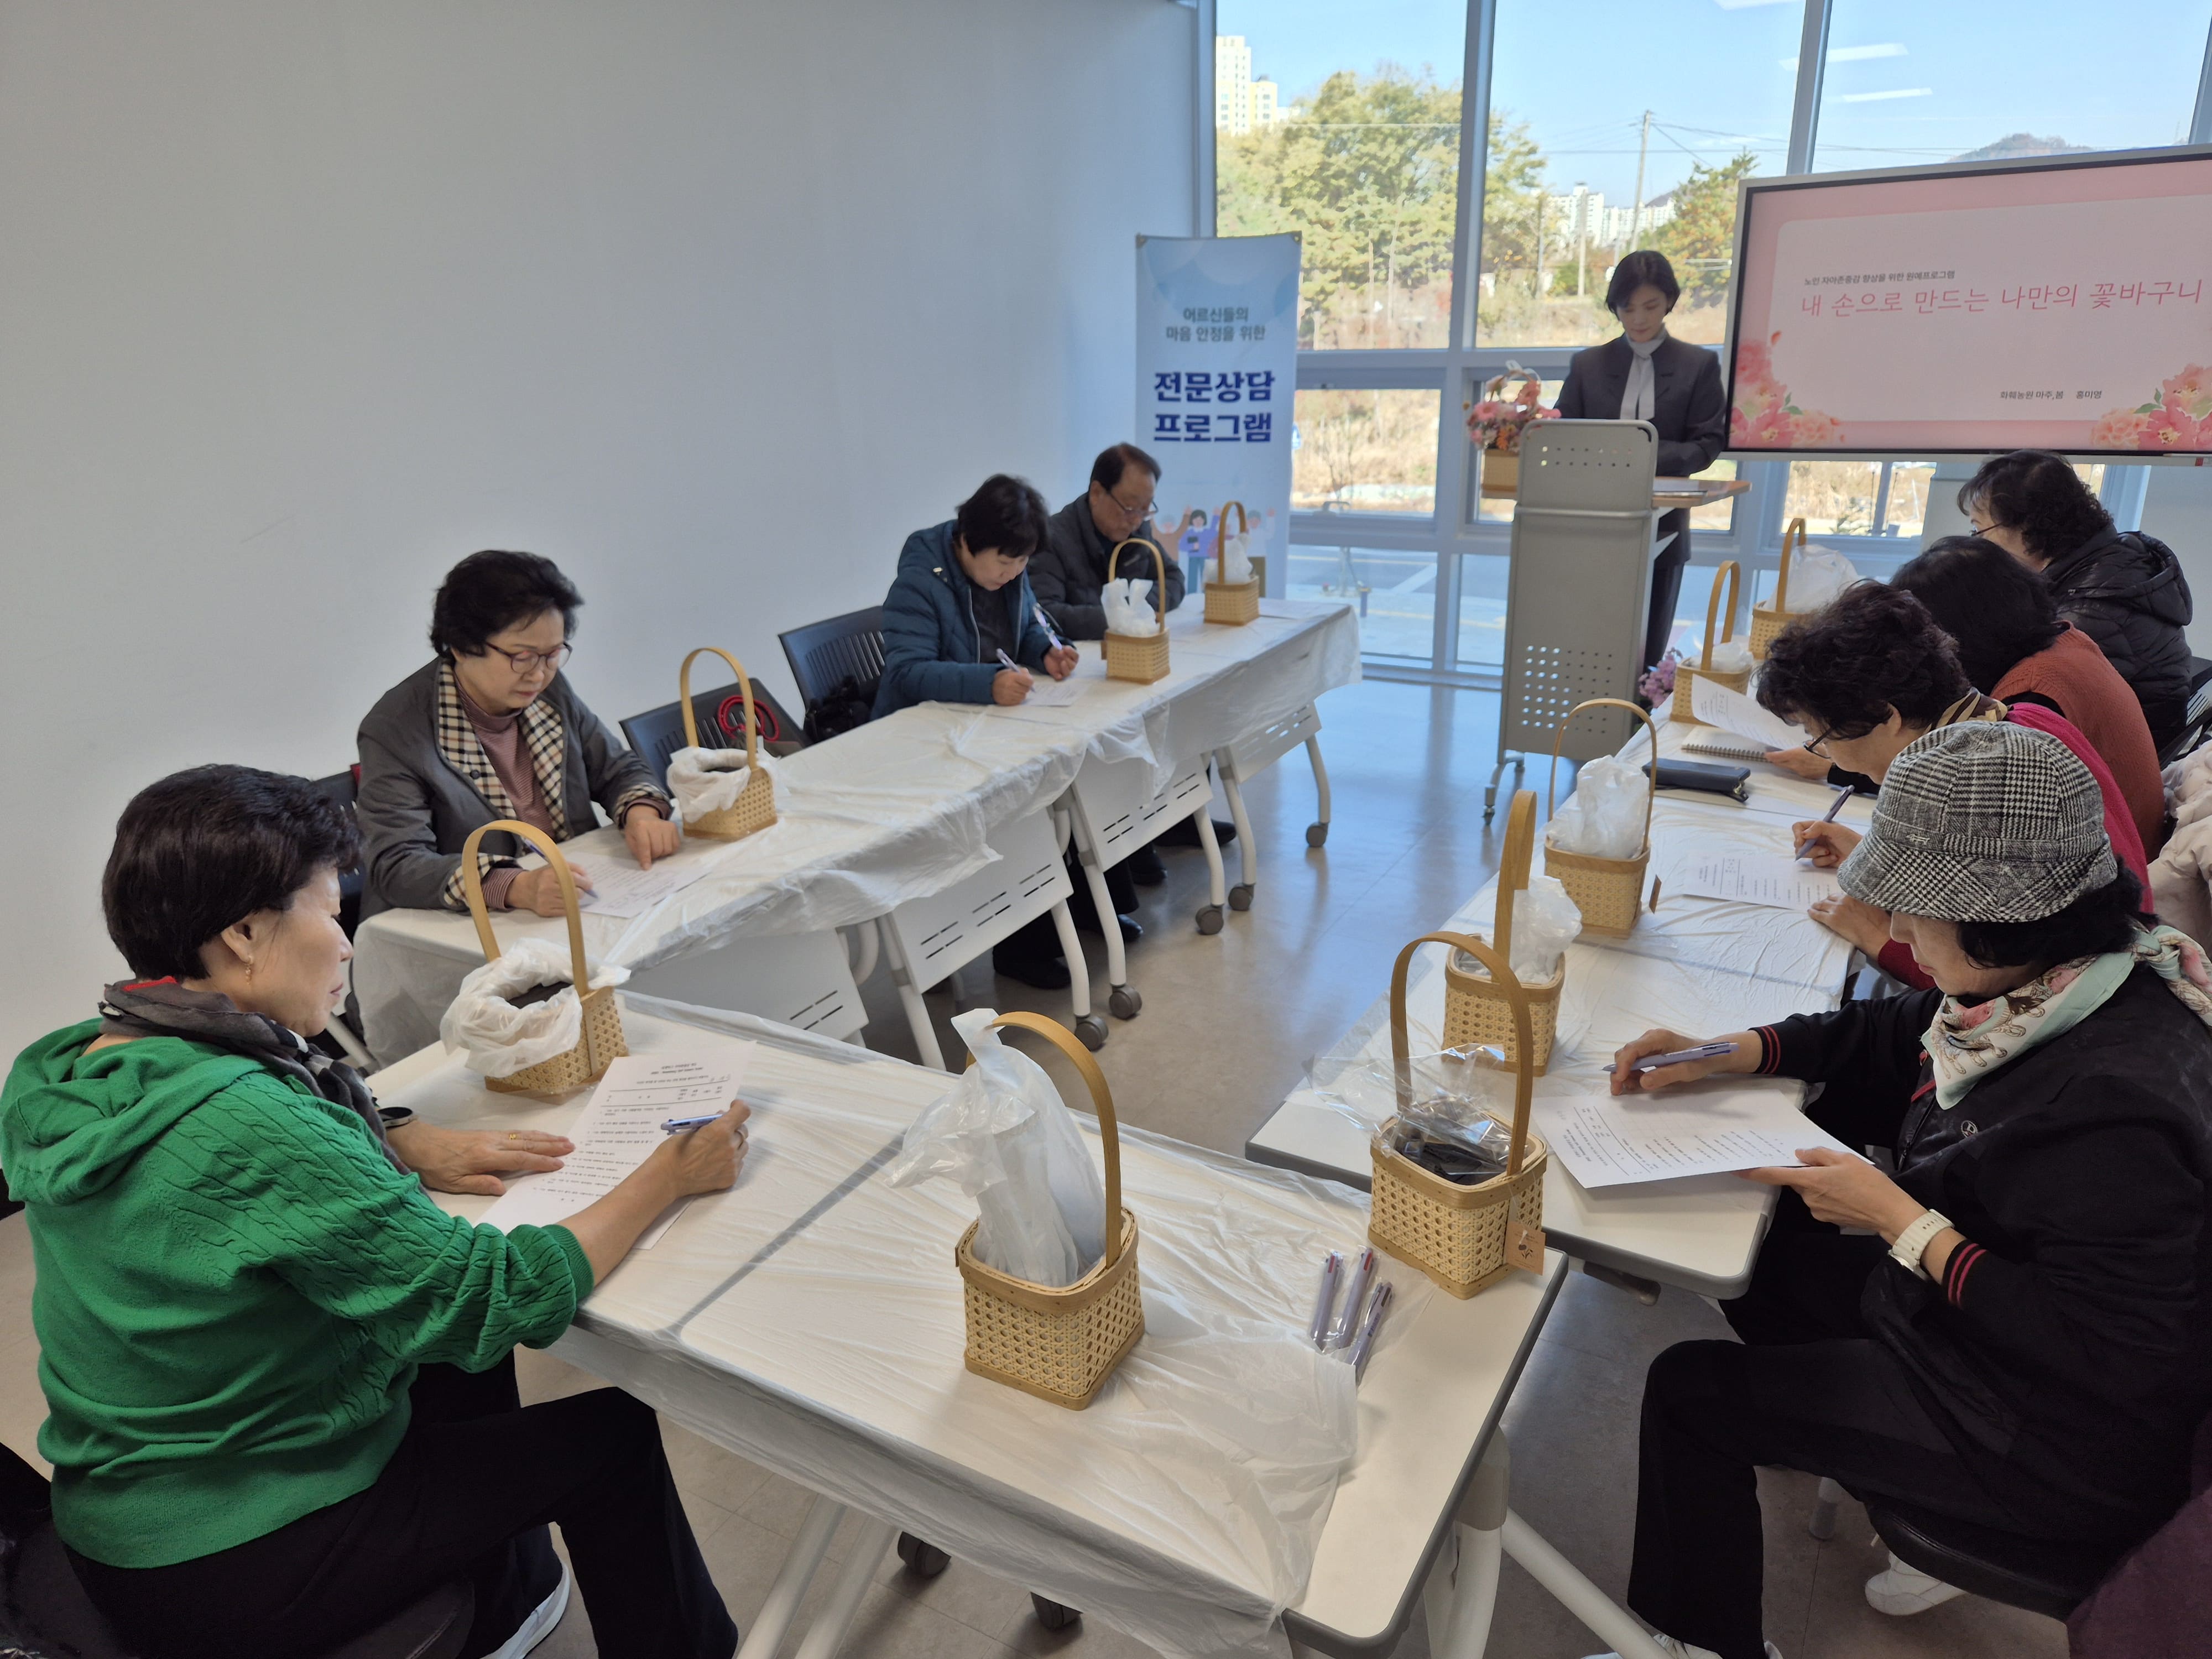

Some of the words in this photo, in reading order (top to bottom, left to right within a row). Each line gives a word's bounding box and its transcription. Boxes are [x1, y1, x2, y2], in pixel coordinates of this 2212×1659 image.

[1804, 278, 1820, 286] 노인
[1821, 275, 1860, 285] 자아존중감
[1888, 272, 1904, 282] 위한
[1906, 270, 1955, 282] 원예프로그램
[1802, 294, 1821, 317] 내
[1832, 293, 1903, 317] 손으로
[1915, 289, 1989, 314] 만드는
[2001, 284, 2078, 310] 나만의
[2090, 279, 2203, 309] 꽃바구니
[1183, 307, 1249, 323] 어르신들의
[1166, 326, 1191, 342] 마음
[1196, 326, 1234, 342] 안정을
[1240, 325, 1266, 341] 위한
[1155, 371, 1275, 403] 전문상담
[1154, 413, 1271, 442] 프로그램
